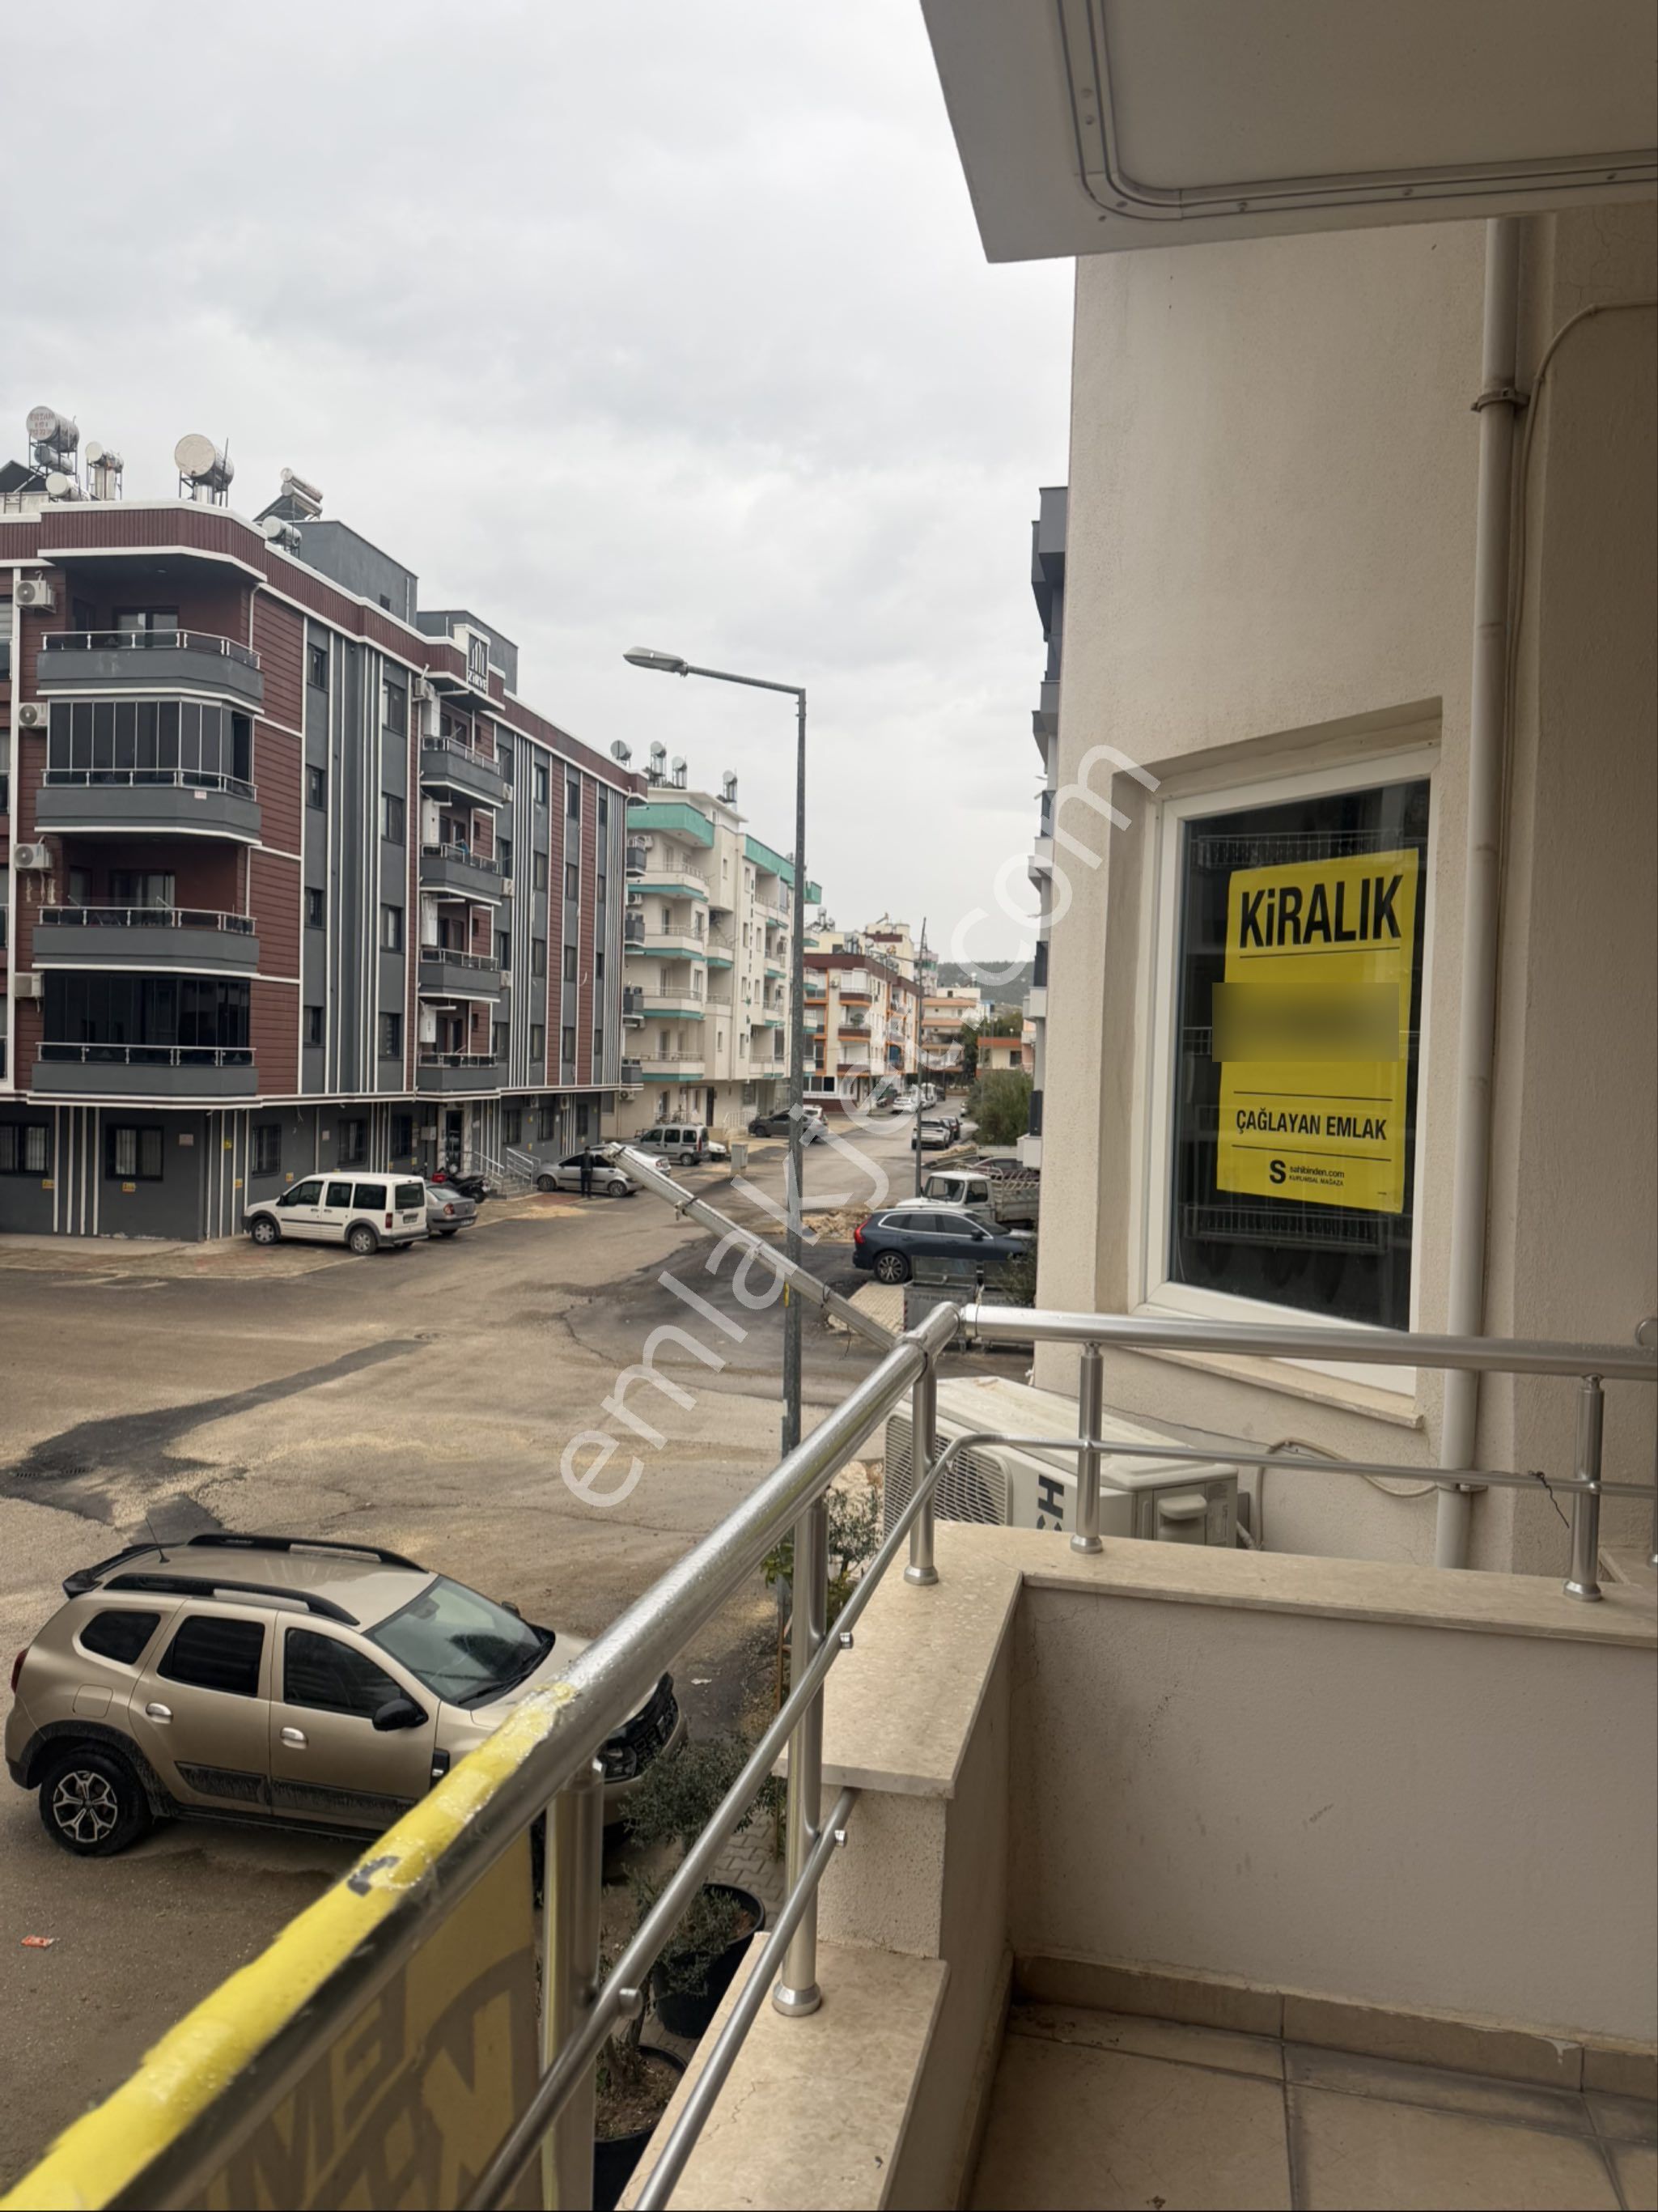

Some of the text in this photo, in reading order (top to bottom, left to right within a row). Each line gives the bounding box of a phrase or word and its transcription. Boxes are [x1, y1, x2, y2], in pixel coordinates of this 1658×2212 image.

[1236, 1107, 1387, 1140] ÇAĞLAYAN EMLAK
[1290, 1165, 1345, 1178] sahibinden.com
